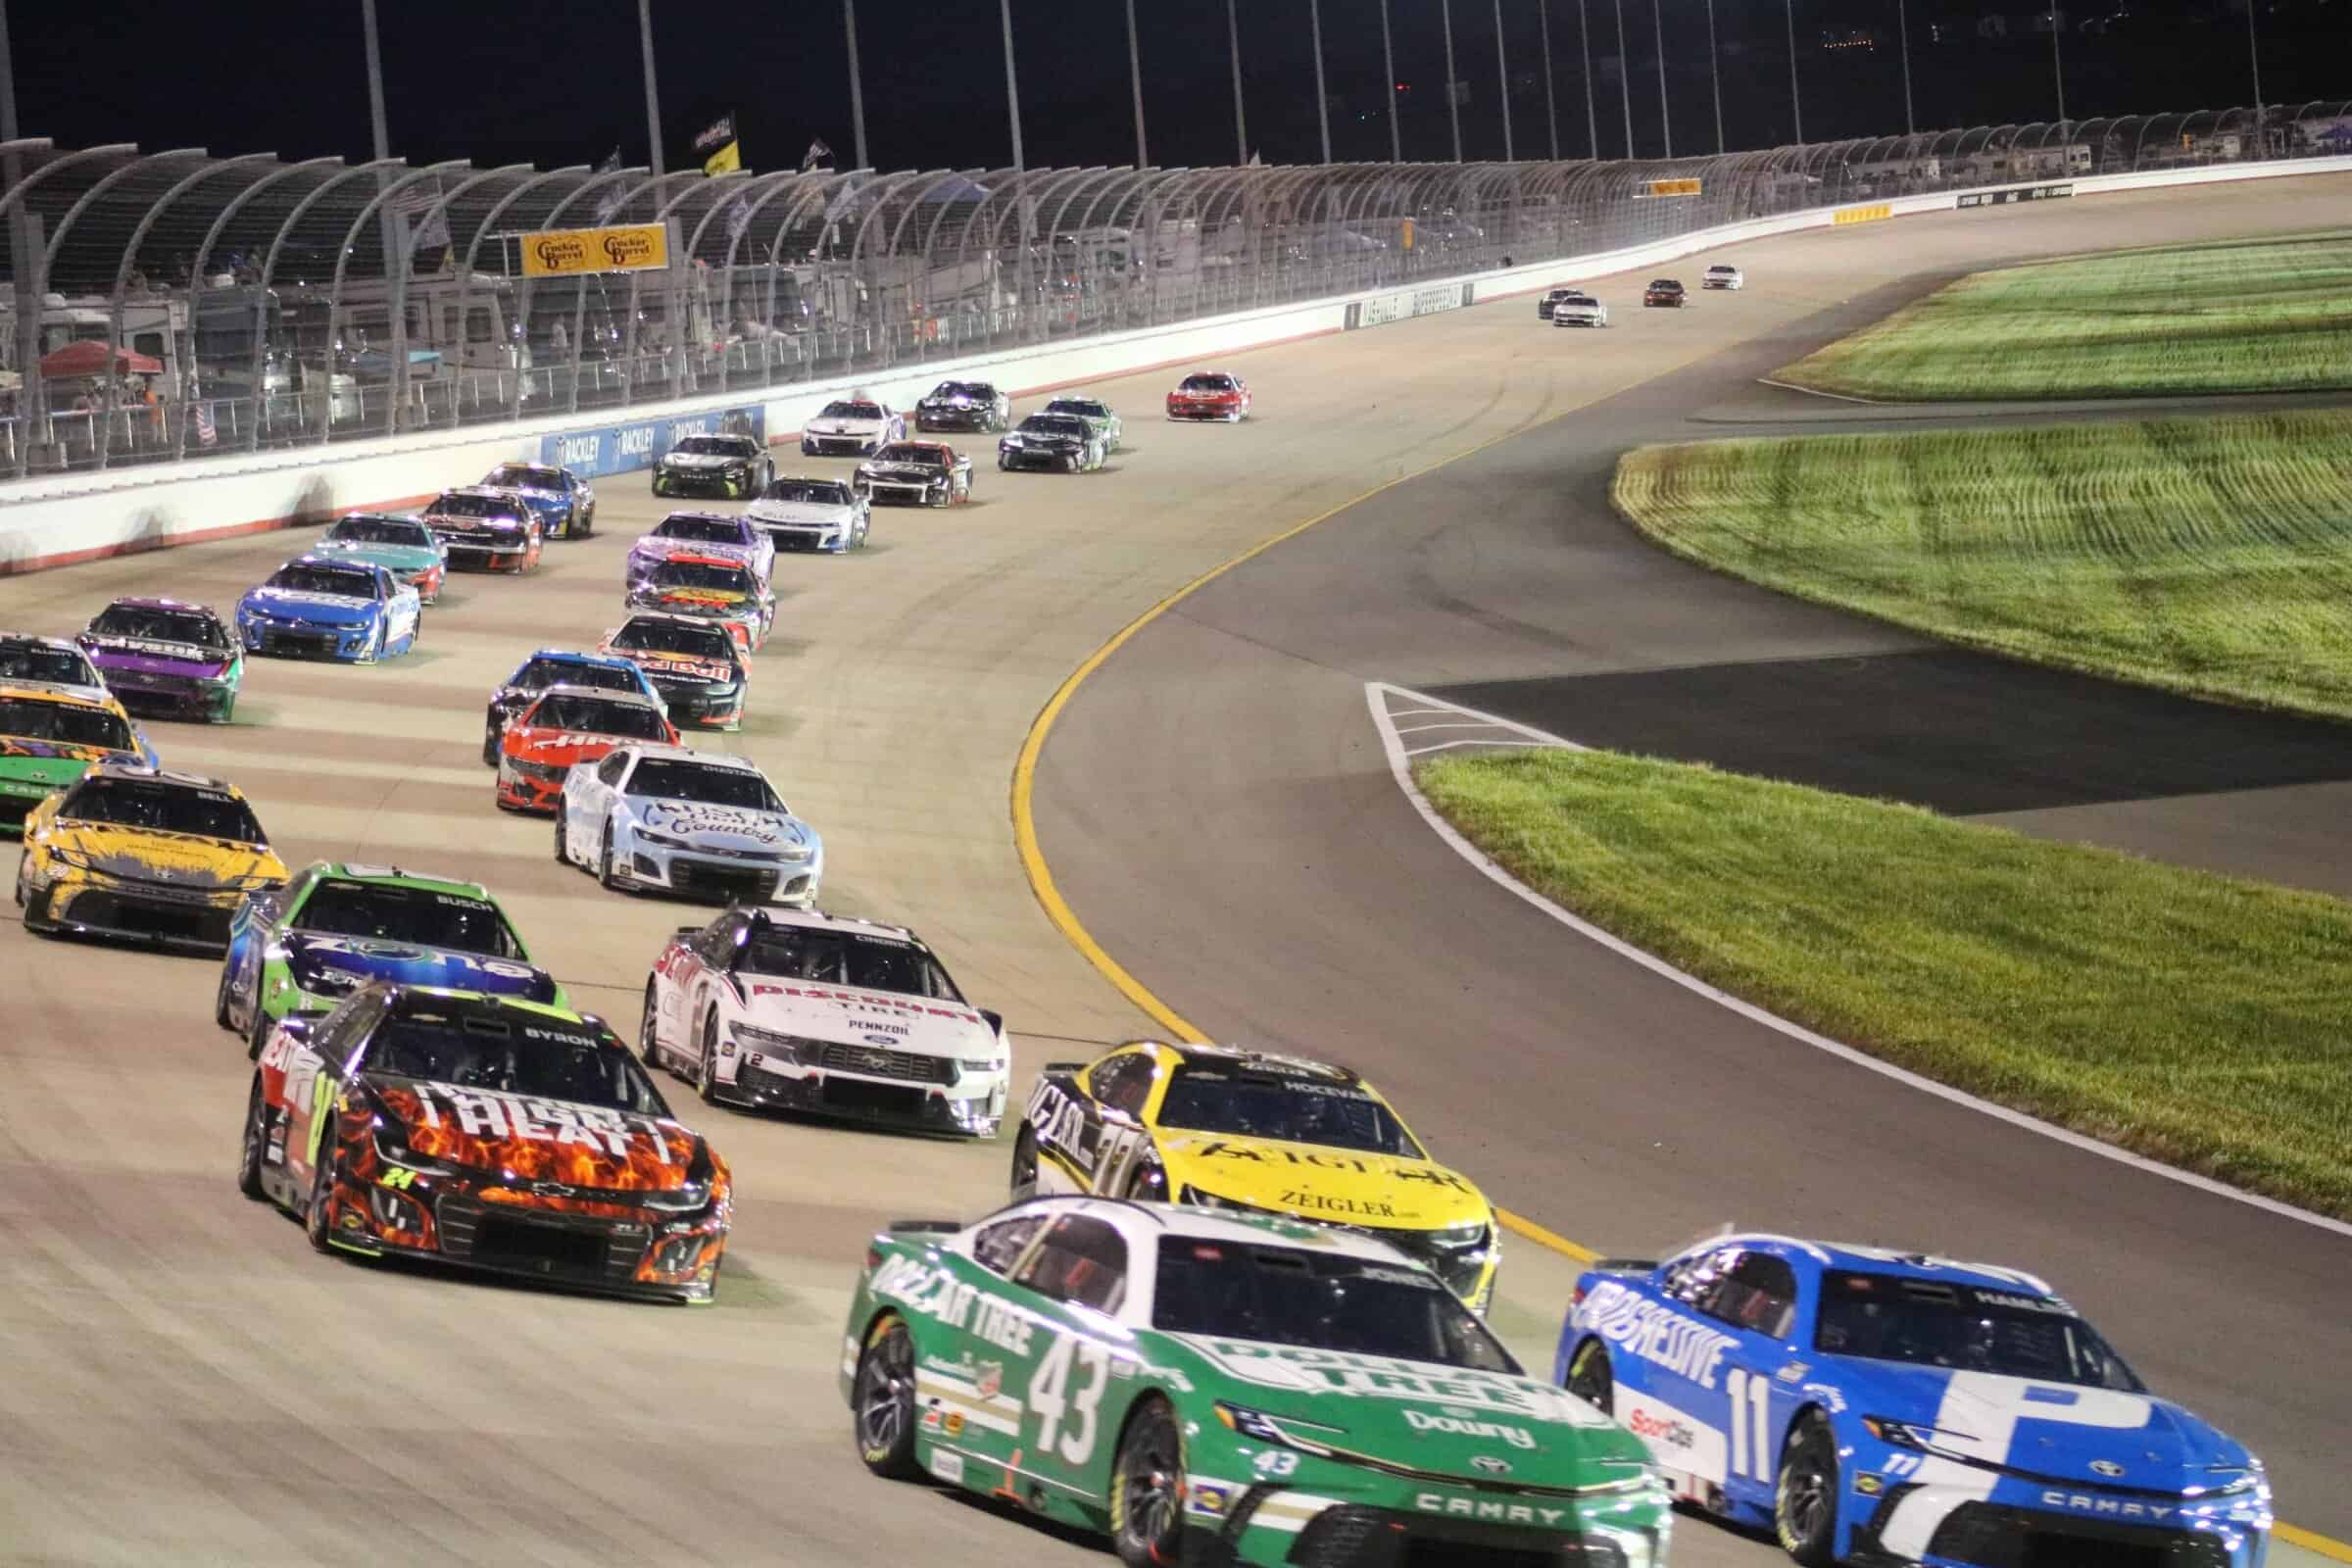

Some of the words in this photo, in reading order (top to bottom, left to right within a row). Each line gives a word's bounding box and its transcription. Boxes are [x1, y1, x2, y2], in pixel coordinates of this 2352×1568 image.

[537, 240, 580, 261] Cracker
[604, 235, 646, 256] Cracker
[612, 245, 650, 265] Barrel
[546, 248, 583, 270] Barrel
[564, 435, 601, 465] RACKLEY
[621, 427, 656, 456] RACKLEY
[670, 818, 777, 844] Country
[436, 894, 493, 913] BUSCH
[524, 1027, 598, 1049] BYRON
[848, 1019, 910, 1037] PENNZOIL
[750, 1053, 763, 1067] 2
[380, 1167, 416, 1191] 24
[1279, 1189, 1396, 1219] ZEIGLER
[971, 1291, 1033, 1357] TREE
[1029, 1333, 1111, 1465] 43
[1403, 1409, 1537, 1449] Downy
[1727, 1367, 1770, 1485] 11
[1251, 1450, 1301, 1477] 43
[1883, 1452, 1922, 1477] 11
[1415, 1493, 1567, 1526] CAMRY
[2040, 1490, 2174, 1520] CAMRY
